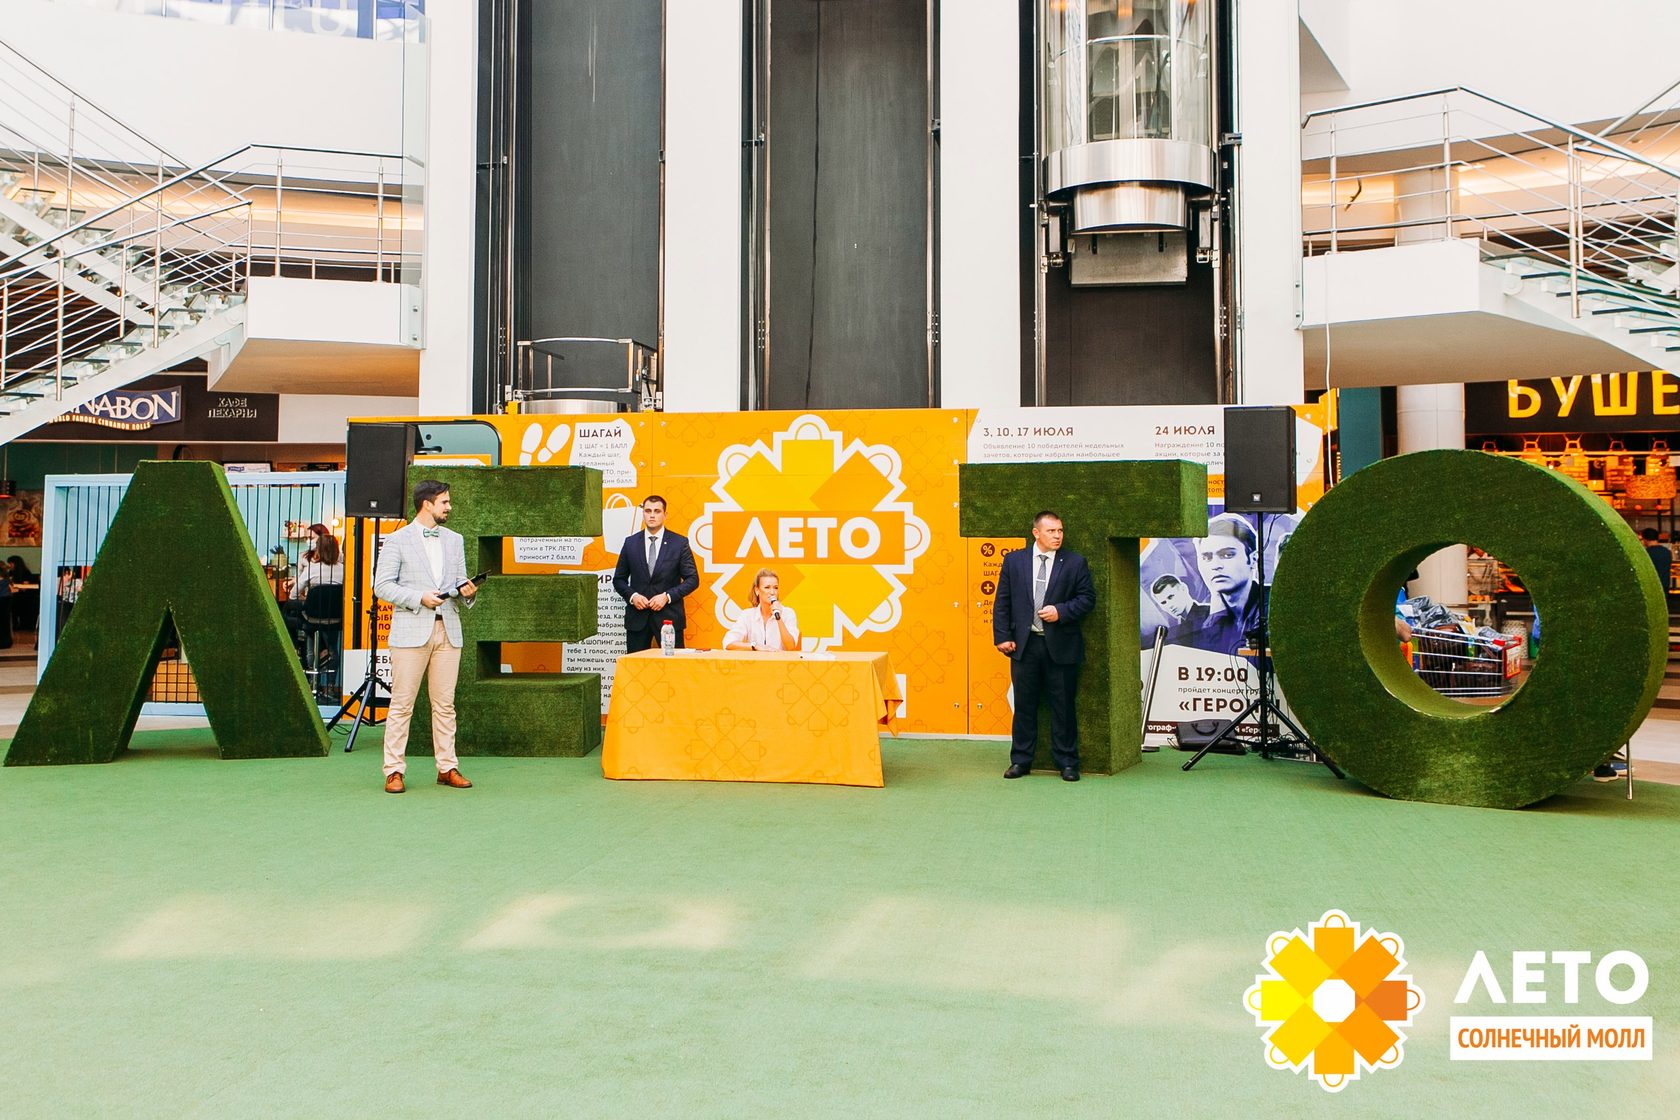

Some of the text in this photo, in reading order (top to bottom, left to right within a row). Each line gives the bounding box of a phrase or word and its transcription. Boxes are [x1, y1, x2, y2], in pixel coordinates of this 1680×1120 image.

[218, 397, 248, 408] КАФЕ
[207, 408, 257, 419] ПЕКАРНЯ
[72, 414, 96, 425] FAMOUS
[98, 418, 130, 430] CINNAMON
[132, 421, 151, 431] ROLLS
[579, 425, 622, 438] ШАГАЙ
[983, 426, 1074, 438] 3, 10, 17 ИЮЛЯ
[1155, 425, 1215, 436] 24 ИЮЛЯ
[983, 442, 1026, 450] Объявление
[1076, 450, 1121, 458] наибольшее
[735, 516, 881, 560] ЛЕТО
[1178, 666, 1248, 682] В 19:00
